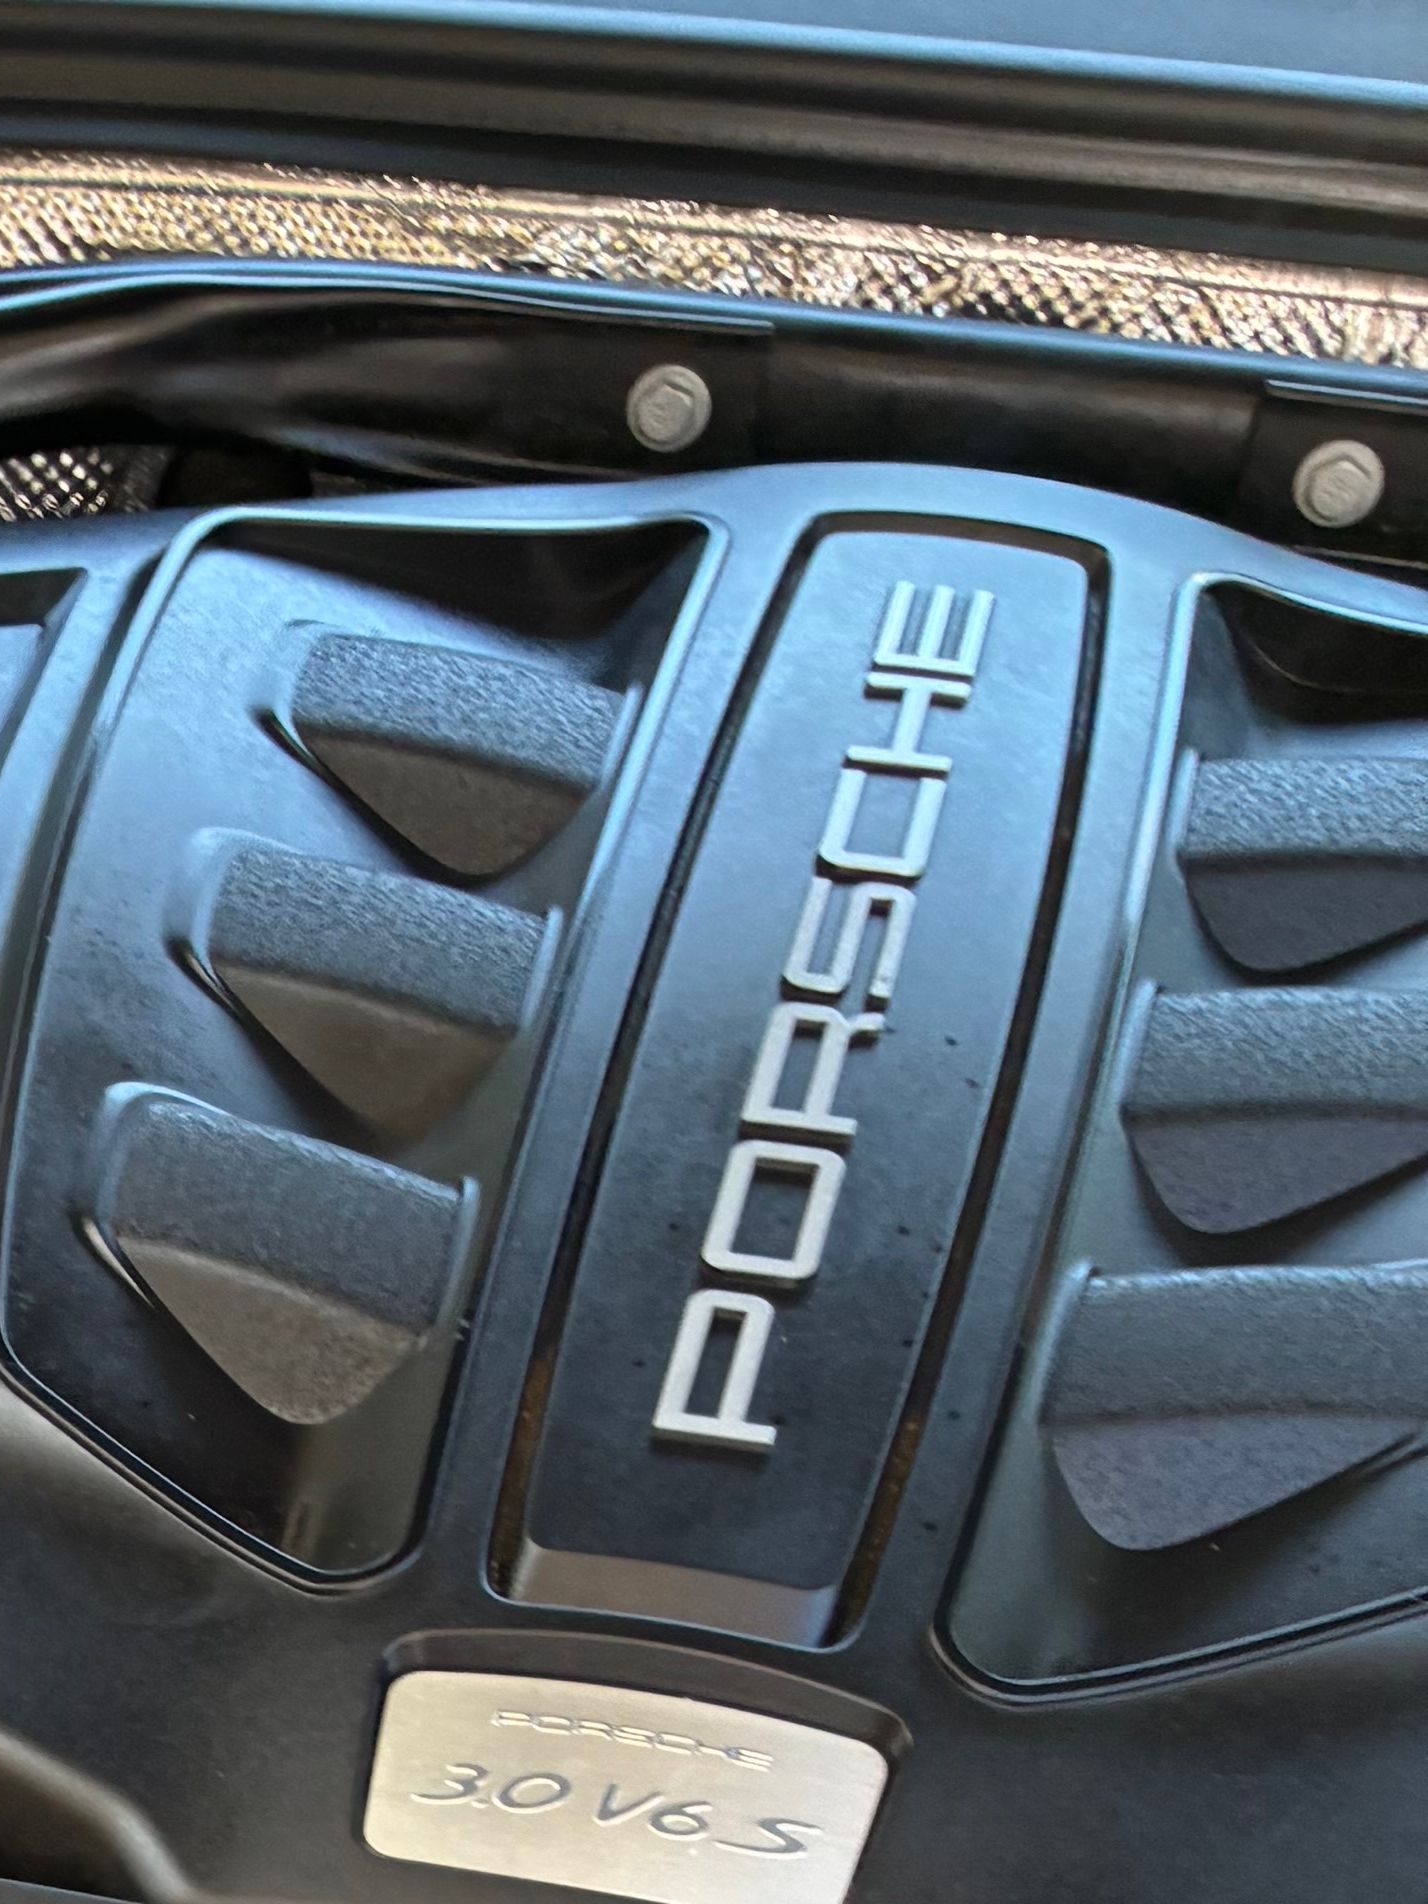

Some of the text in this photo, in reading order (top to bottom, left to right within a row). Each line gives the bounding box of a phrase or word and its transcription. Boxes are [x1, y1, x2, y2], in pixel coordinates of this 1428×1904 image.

[652, 580, 996, 1450] PORSCHE
[490, 1709, 775, 1773] PORSCHE
[411, 1762, 825, 1860] 3.0 V6 S
